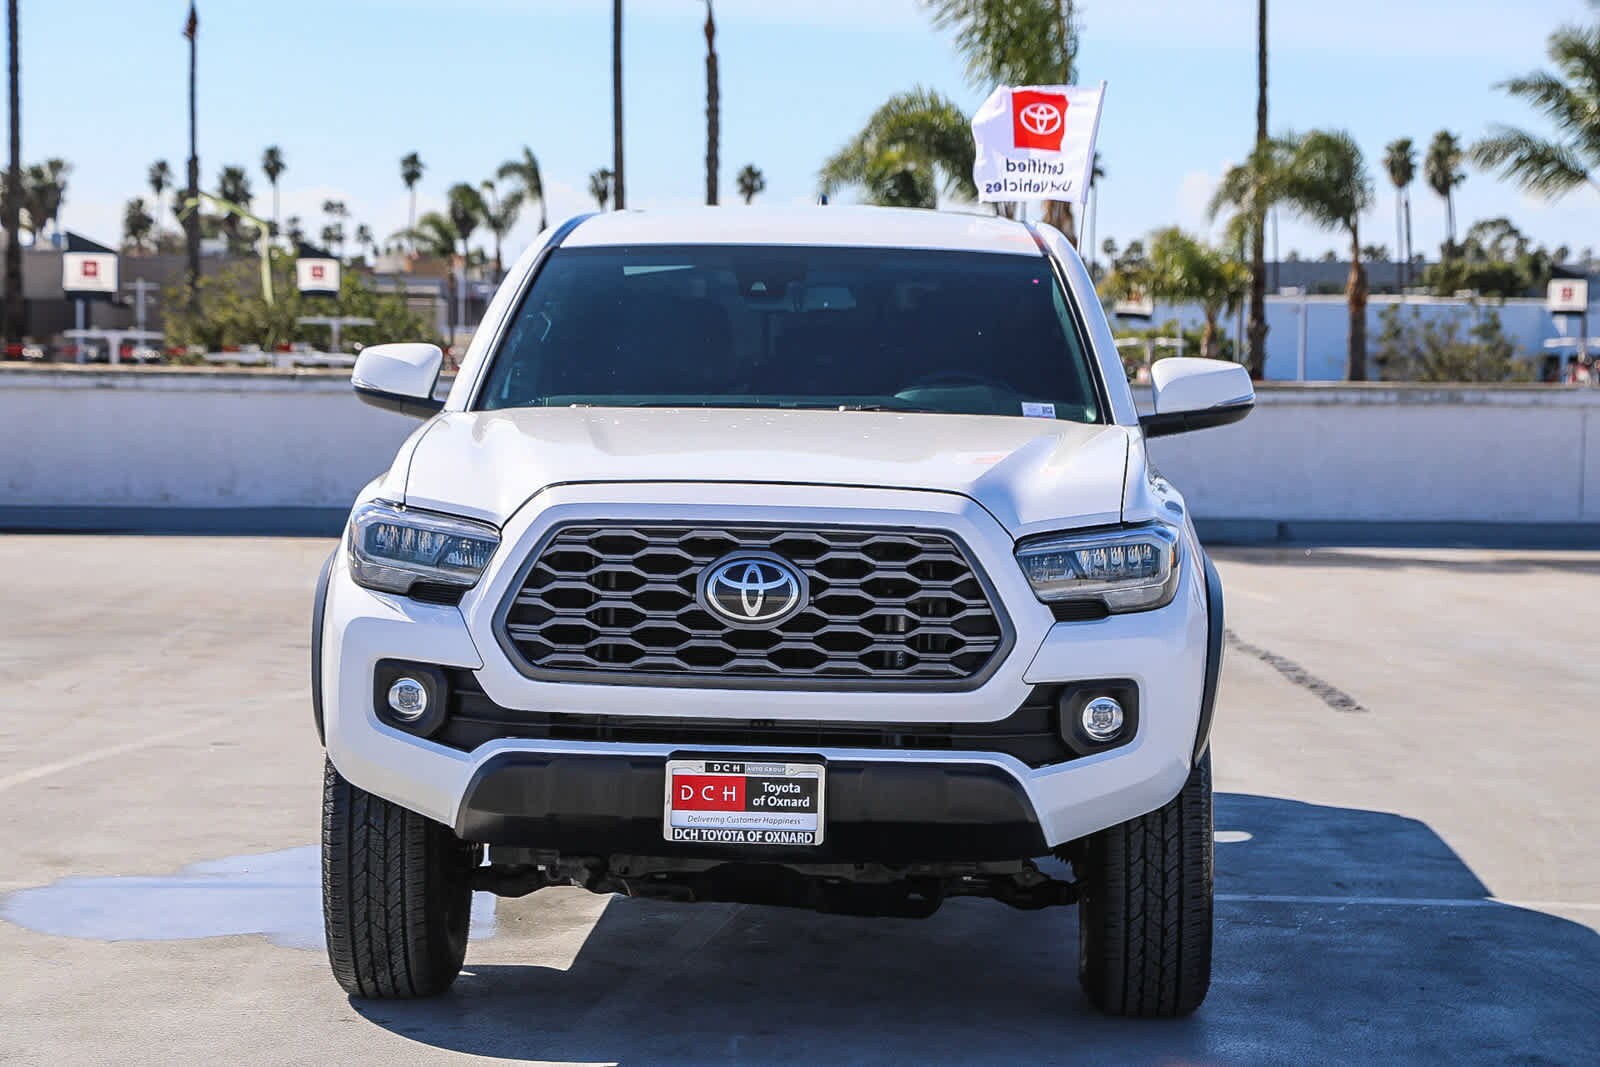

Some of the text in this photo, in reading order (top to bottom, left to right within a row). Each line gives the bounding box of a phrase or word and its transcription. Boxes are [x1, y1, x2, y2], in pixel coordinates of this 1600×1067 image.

[713, 764, 740, 772] DCH
[681, 785, 736, 801] DCH
[762, 782, 800, 794] Toyota
[752, 796, 810, 807] of Oxnard
[687, 815, 725, 825] Delivering
[726, 816, 763, 824] Customer
[674, 829, 813, 843] DCH TOYOTA OF OXNARD
